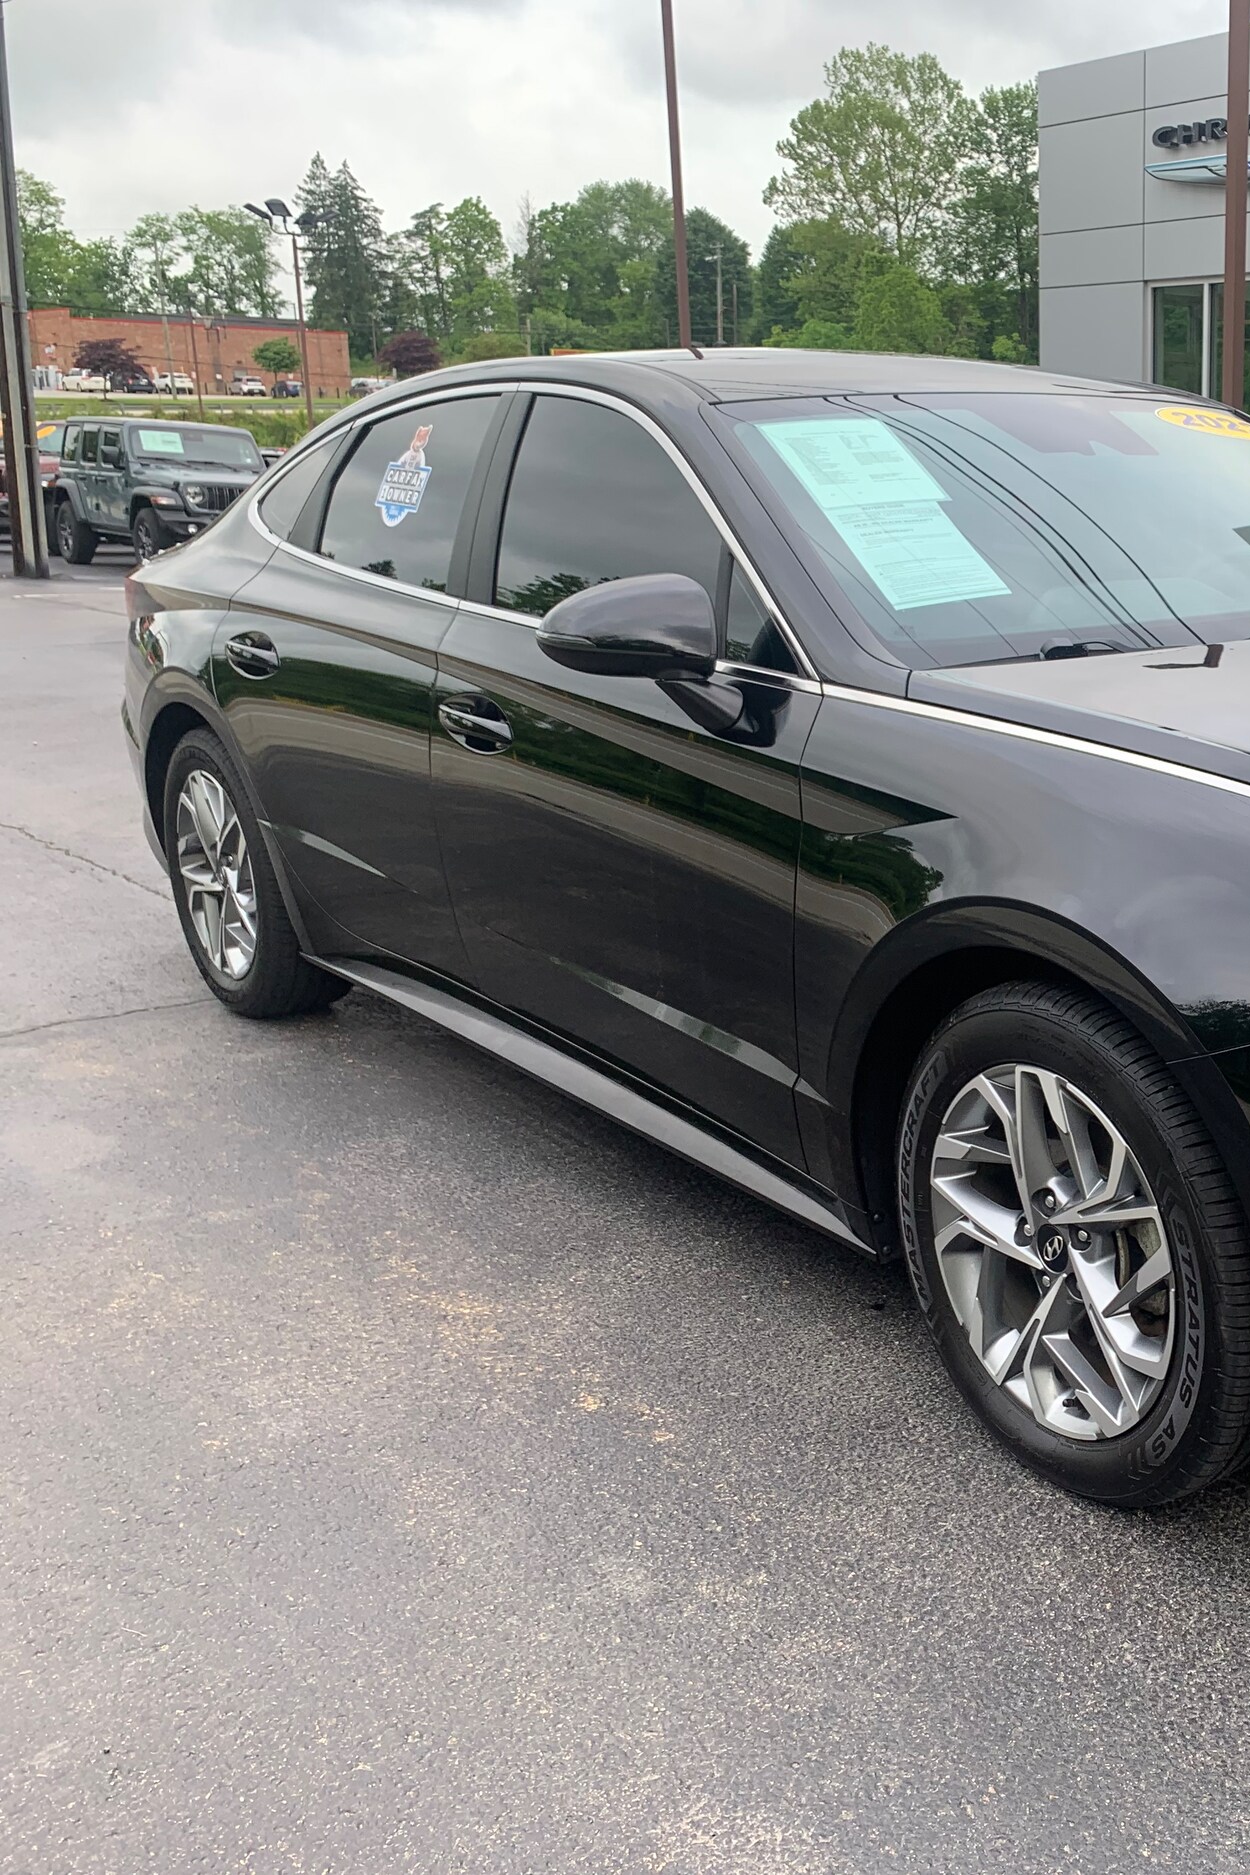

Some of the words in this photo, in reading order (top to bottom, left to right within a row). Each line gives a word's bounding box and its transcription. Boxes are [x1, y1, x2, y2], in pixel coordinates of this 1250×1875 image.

[387, 487, 420, 505] OWNER
[1172, 1217, 1202, 1410] STRATUS
[1151, 1414, 1177, 1461] AS
